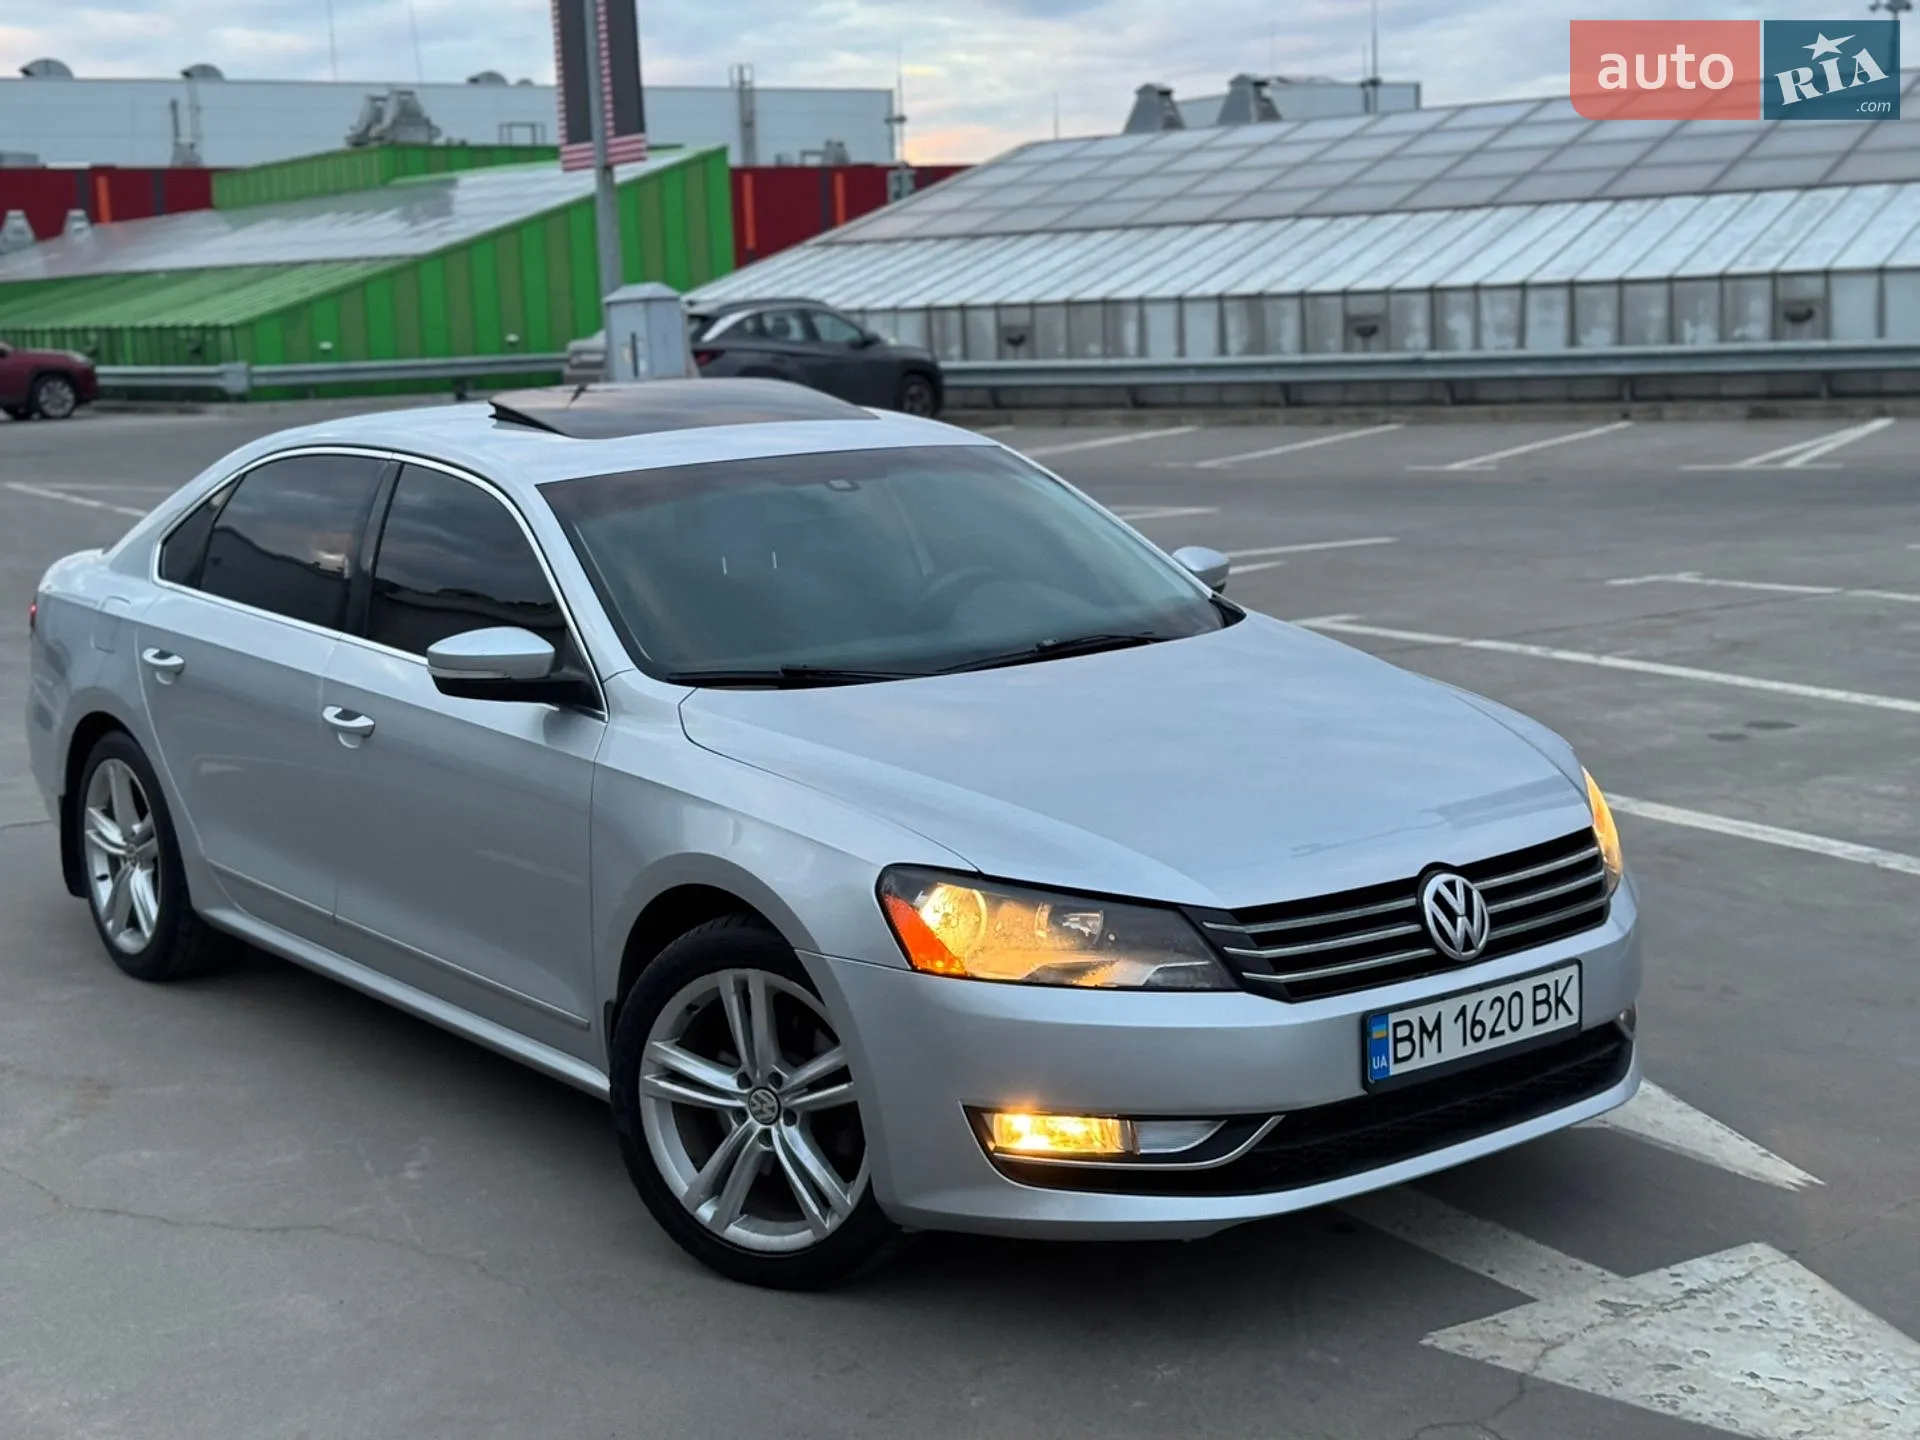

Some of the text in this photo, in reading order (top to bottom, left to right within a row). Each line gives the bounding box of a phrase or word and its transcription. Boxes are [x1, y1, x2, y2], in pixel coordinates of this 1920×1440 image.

[1392, 975, 1574, 1064] BM 1620 BK
[1372, 1055, 1388, 1069] UA
